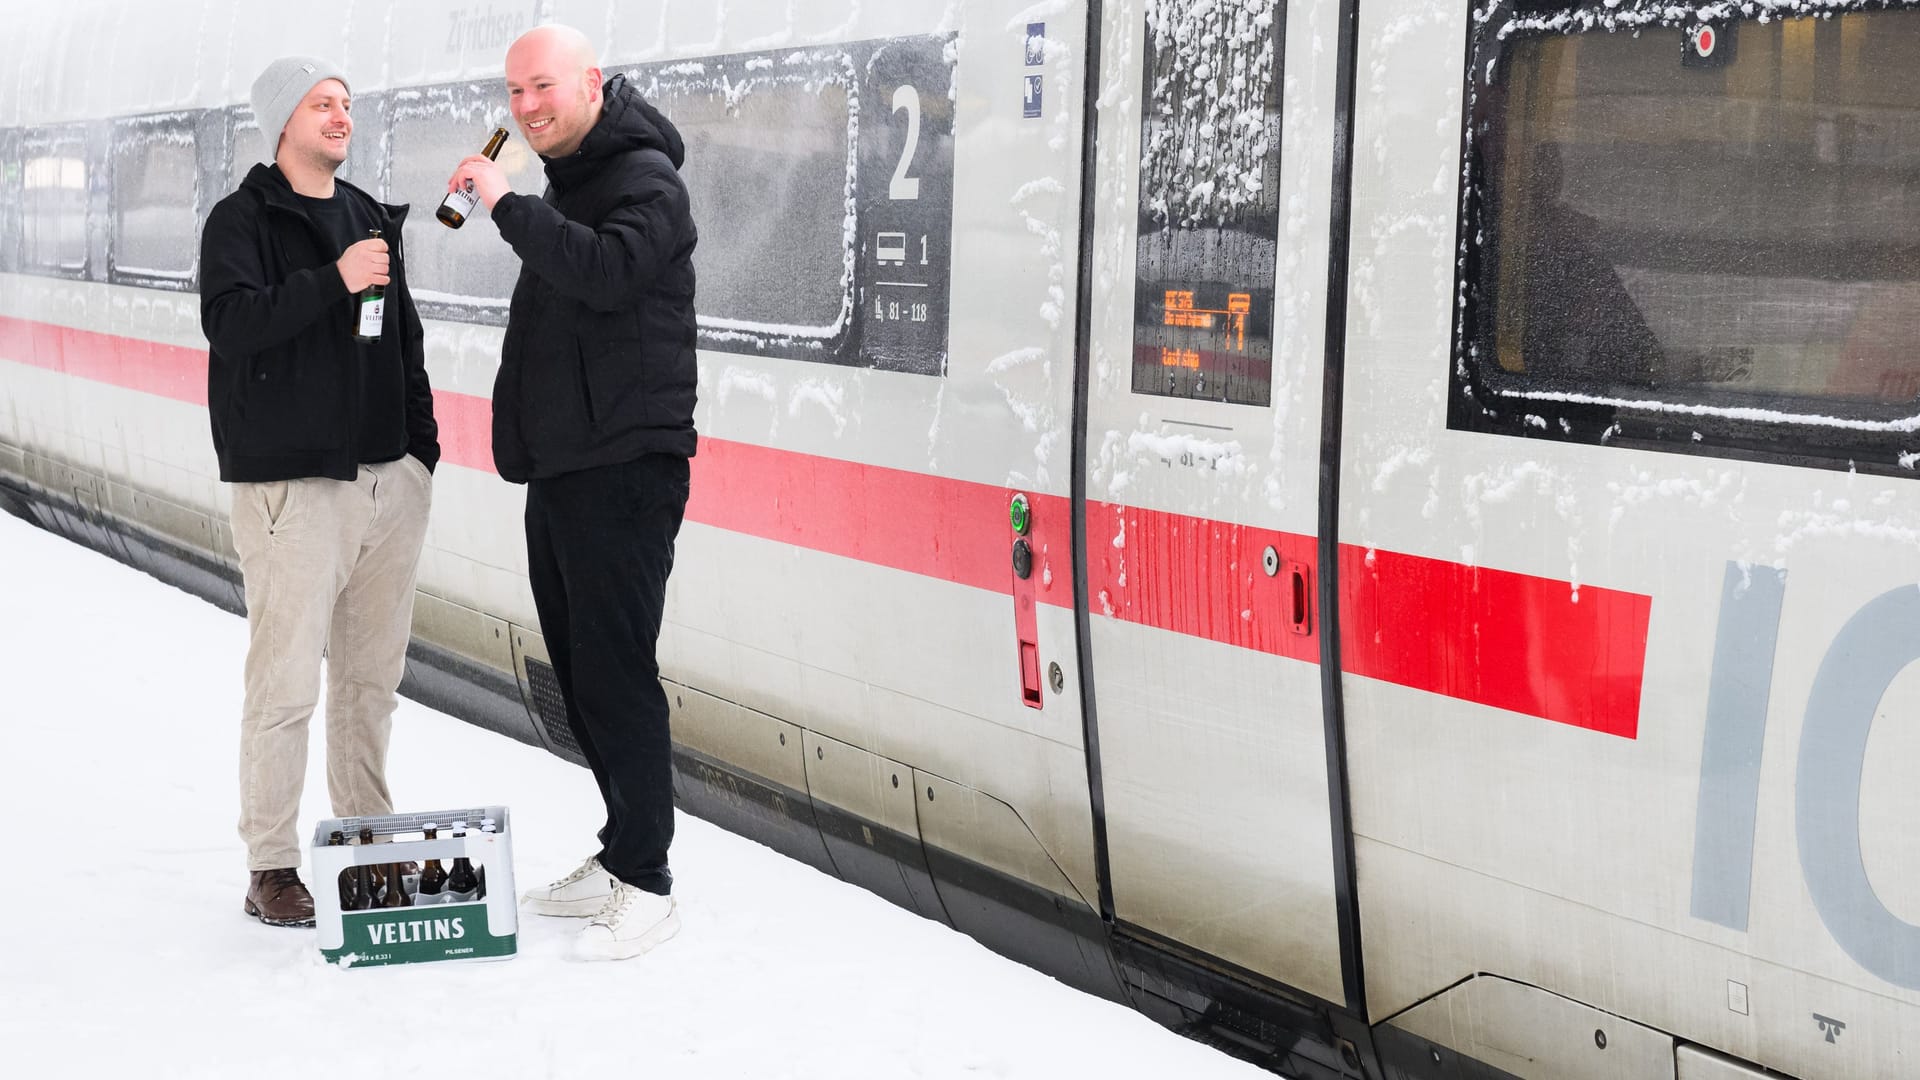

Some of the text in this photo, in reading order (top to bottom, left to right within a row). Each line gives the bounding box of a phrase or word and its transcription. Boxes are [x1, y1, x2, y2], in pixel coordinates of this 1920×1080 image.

[889, 84, 920, 200] 2
[920, 234, 929, 265] 1
[889, 302, 900, 320] 81
[911, 303, 927, 322] 118
[367, 917, 465, 945] VELTINS
[444, 947, 473, 955] PILSENER
